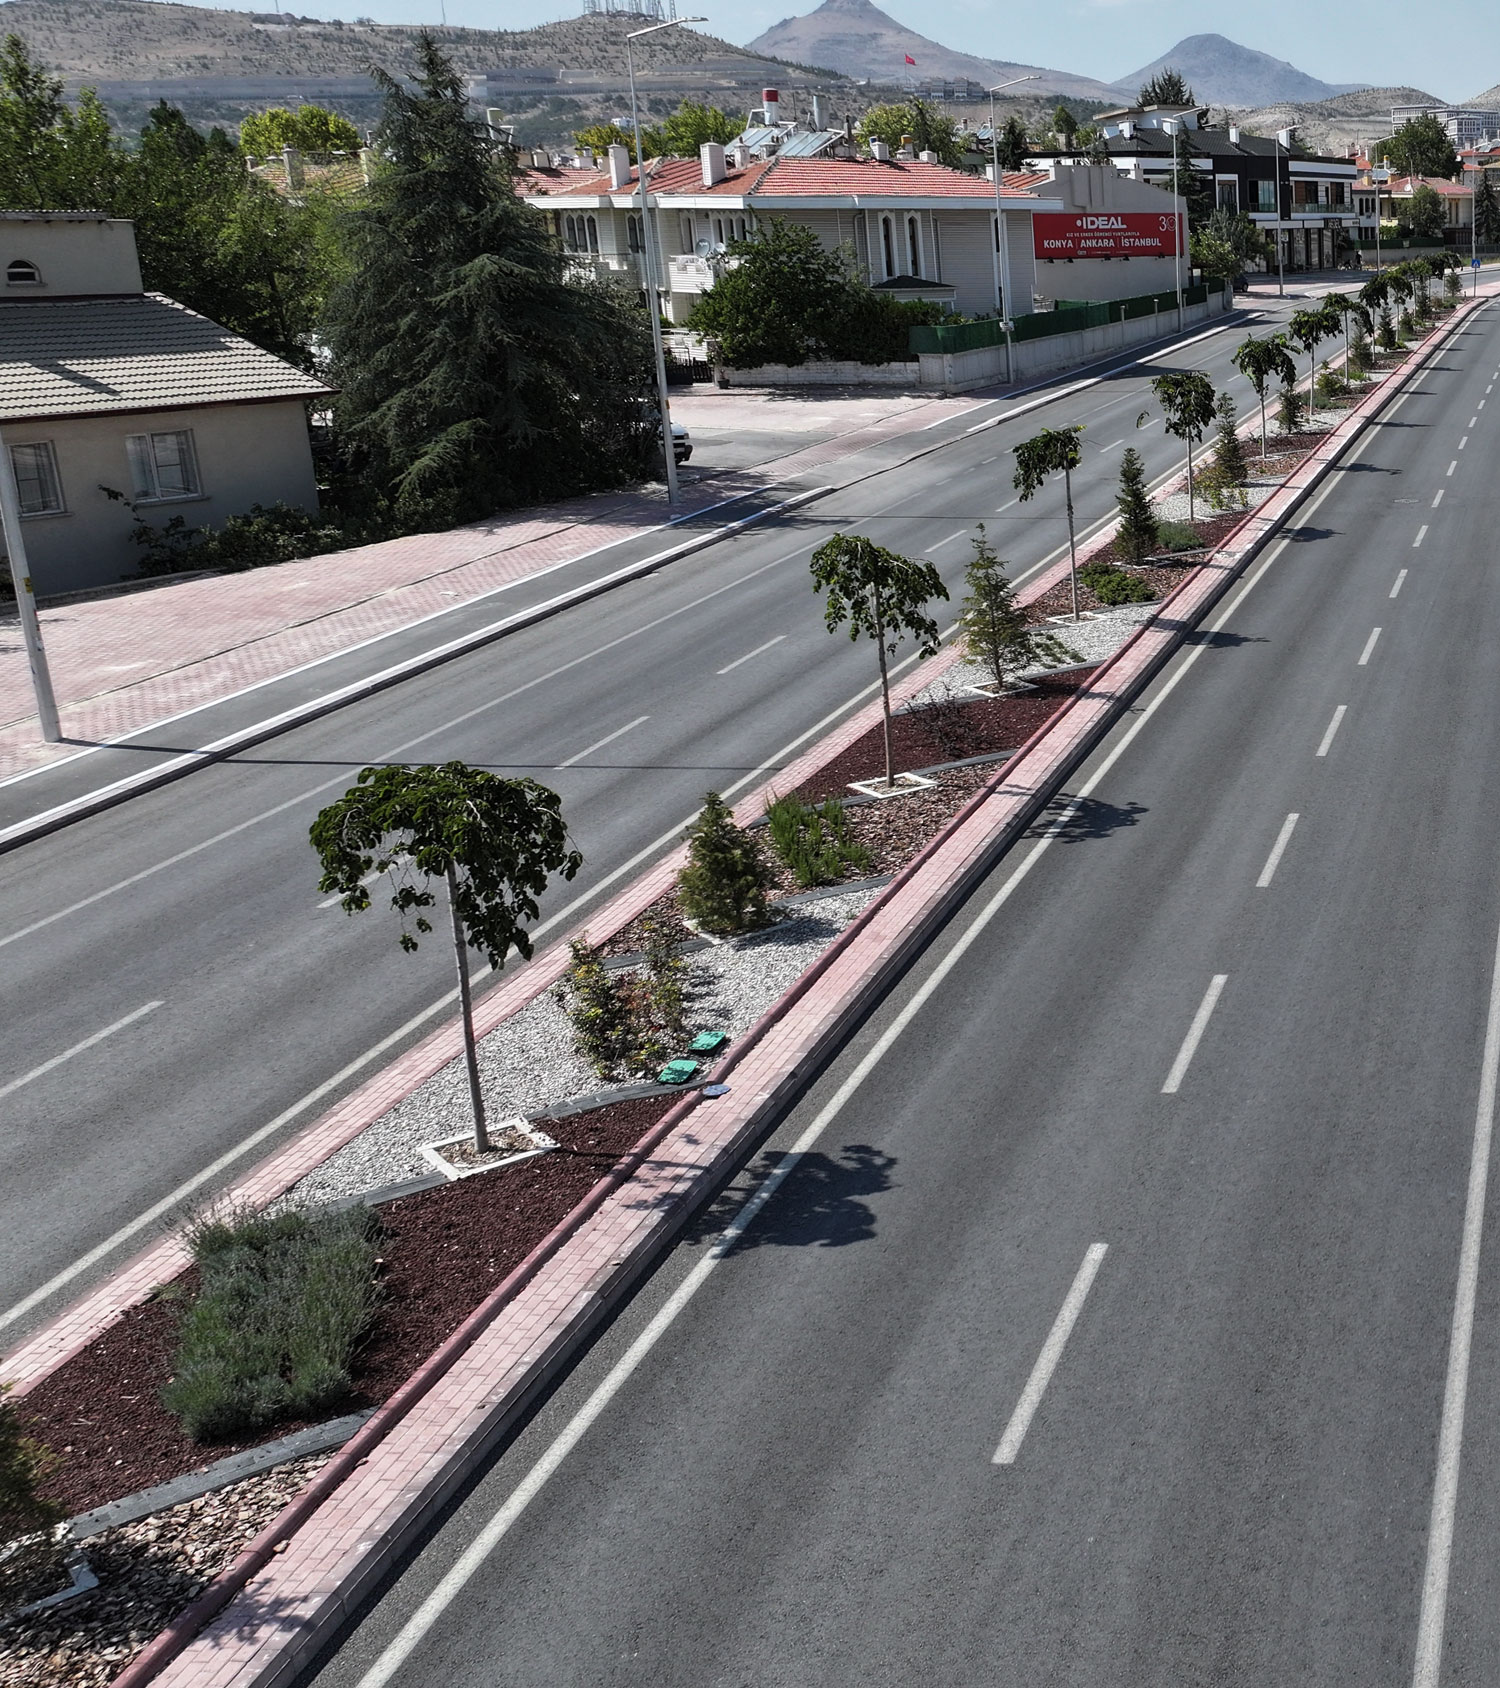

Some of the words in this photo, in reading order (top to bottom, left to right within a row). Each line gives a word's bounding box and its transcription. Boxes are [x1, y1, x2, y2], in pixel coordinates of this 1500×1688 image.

[1043, 239, 1074, 248] KONYA
[1080, 239, 1115, 248] ANKARA
[1121, 236, 1161, 247] İSTANBUL
